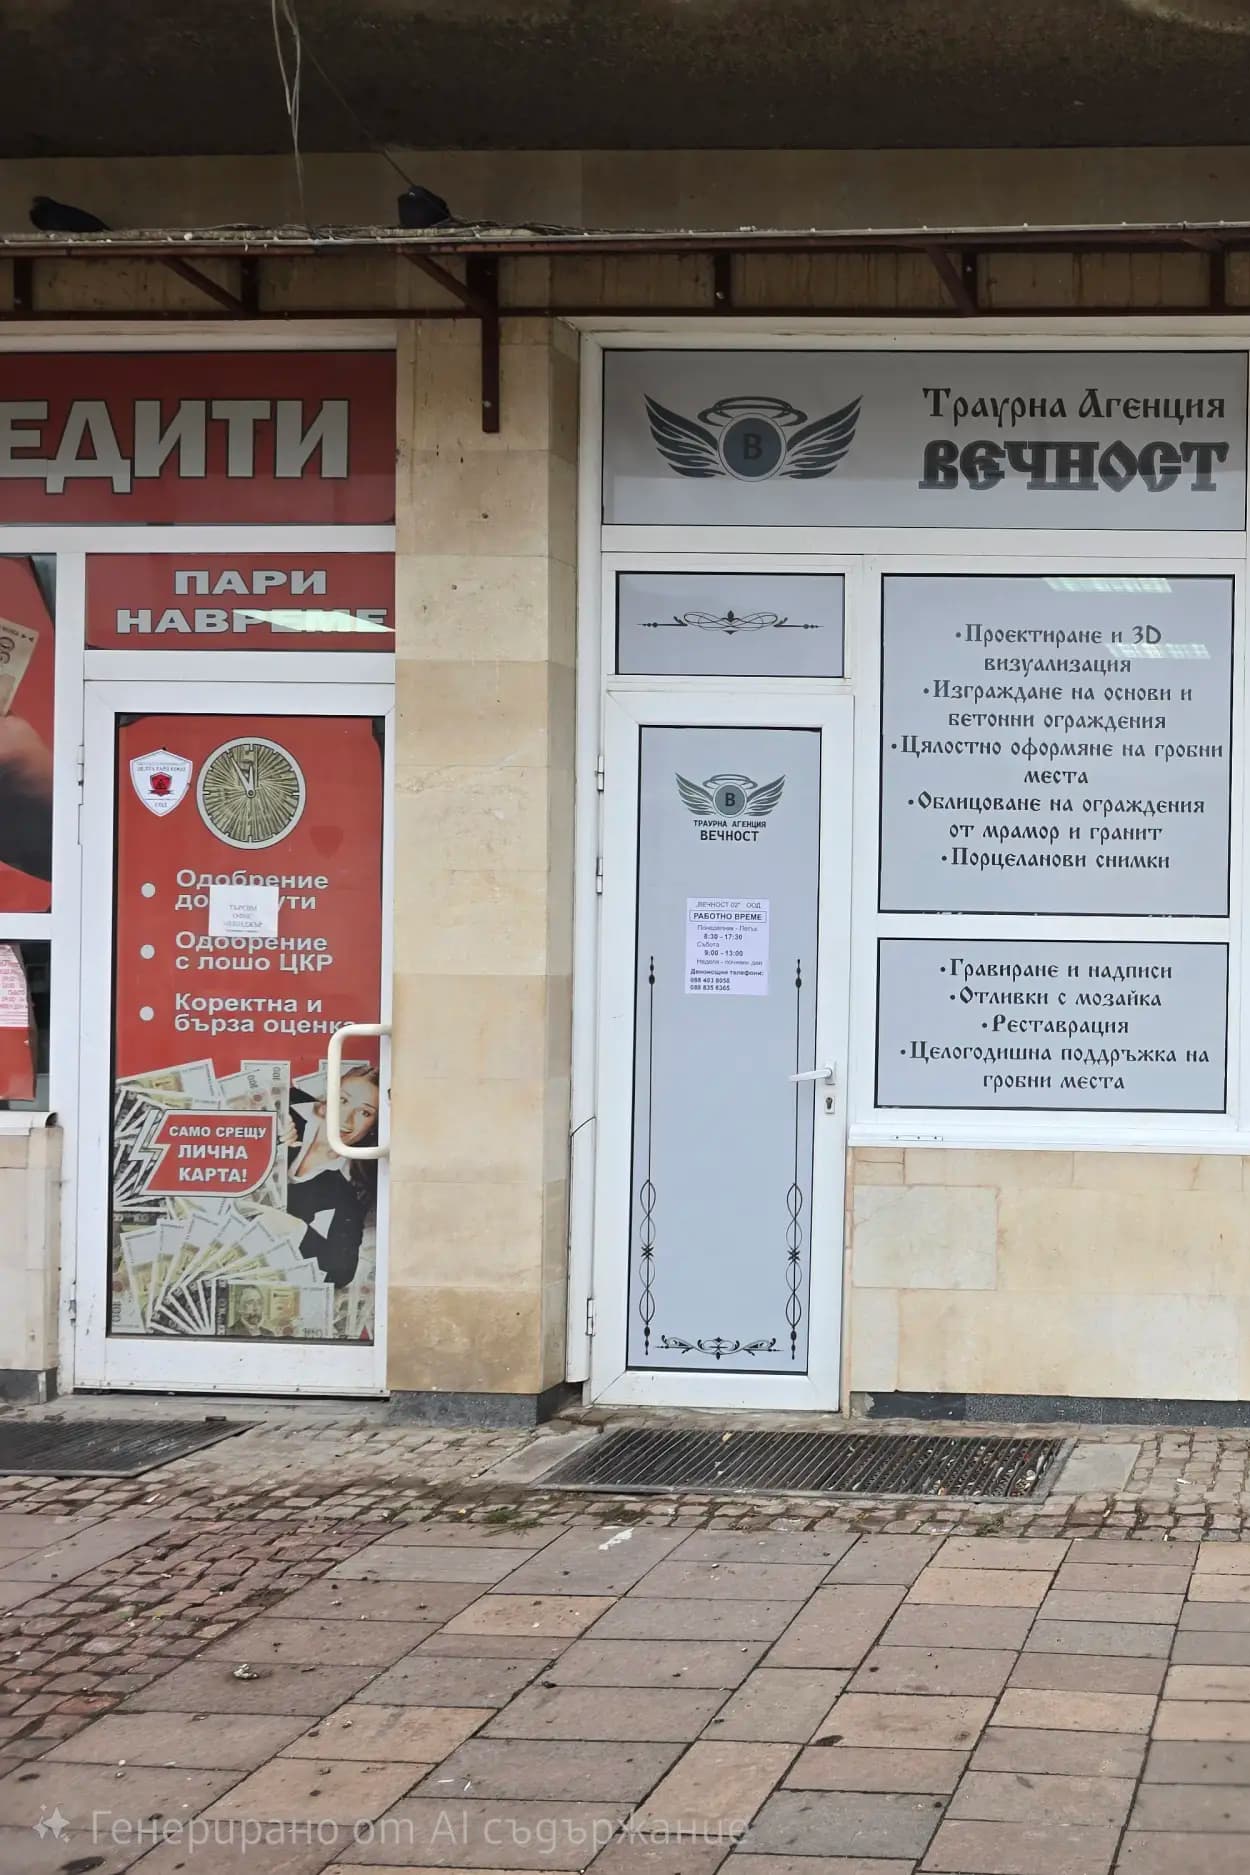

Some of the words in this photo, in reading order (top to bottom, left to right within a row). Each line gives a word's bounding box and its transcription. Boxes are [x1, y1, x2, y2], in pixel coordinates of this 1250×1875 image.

[921, 387, 1067, 428] Траурна
[1078, 388, 1225, 426] Агенция
[919, 440, 1229, 492] ВЕЧНОСТ
[175, 570, 327, 594] ПАРИ
[116, 609, 387, 633] НАВРЕ
[965, 623, 1102, 648] Проектиране
[1112, 631, 1122, 644] и
[1132, 626, 1162, 644] 3D
[984, 657, 1131, 678] визуализация
[932, 679, 1063, 705] Изграждане
[1071, 687, 1095, 701] на
[1103, 687, 1171, 702] основи
[1180, 688, 1192, 701] и
[948, 713, 1035, 728] бетонни
[1043, 714, 1166, 734] ограждения
[900, 735, 1002, 759] Цялостно
[1010, 736, 1114, 762] оформяне
[1122, 743, 1146, 757] на
[1154, 744, 1223, 763] гробни
[1023, 770, 1089, 785] места
[917, 790, 1041, 814] Облицоване
[1050, 798, 1074, 812] на
[1082, 798, 1205, 818] ограждения
[700, 830, 759, 842] ВЕЧНОСТ
[949, 823, 975, 838] от
[982, 825, 1060, 846] мрамор
[1069, 826, 1081, 840] и
[1090, 826, 1163, 846] гранит
[950, 847, 1087, 872] Порцеланови
[1095, 854, 1170, 869] снимки
[176, 869, 328, 889] Одобрение
[198, 956, 270, 970] лошо
[280, 954, 333, 974] ЦКР
[949, 958, 1059, 983] Гравиране
[1067, 965, 1079, 978] и
[1088, 965, 1172, 983] надписи
[175, 993, 297, 1015] Коректна
[307, 1000, 322, 1012] и
[959, 985, 1049, 1005] Отливки
[1057, 992, 1067, 1006] с
[1075, 990, 1162, 1007] мозайка
[175, 1014, 254, 1035] бърза
[991, 1014, 1129, 1039] Реставрация
[909, 1040, 1052, 1065] Целогодишна
[1061, 1047, 1177, 1068] поддръжка
[1186, 1050, 1210, 1063] на
[983, 1074, 1052, 1094] гробни
[1060, 1075, 1125, 1090] места
[169, 1126, 211, 1137] САМО
[216, 1126, 267, 1140] СРЕЩУ
[178, 1145, 248, 1160] ЛИЧНА
[179, 1168, 247, 1183] КАРТА!
